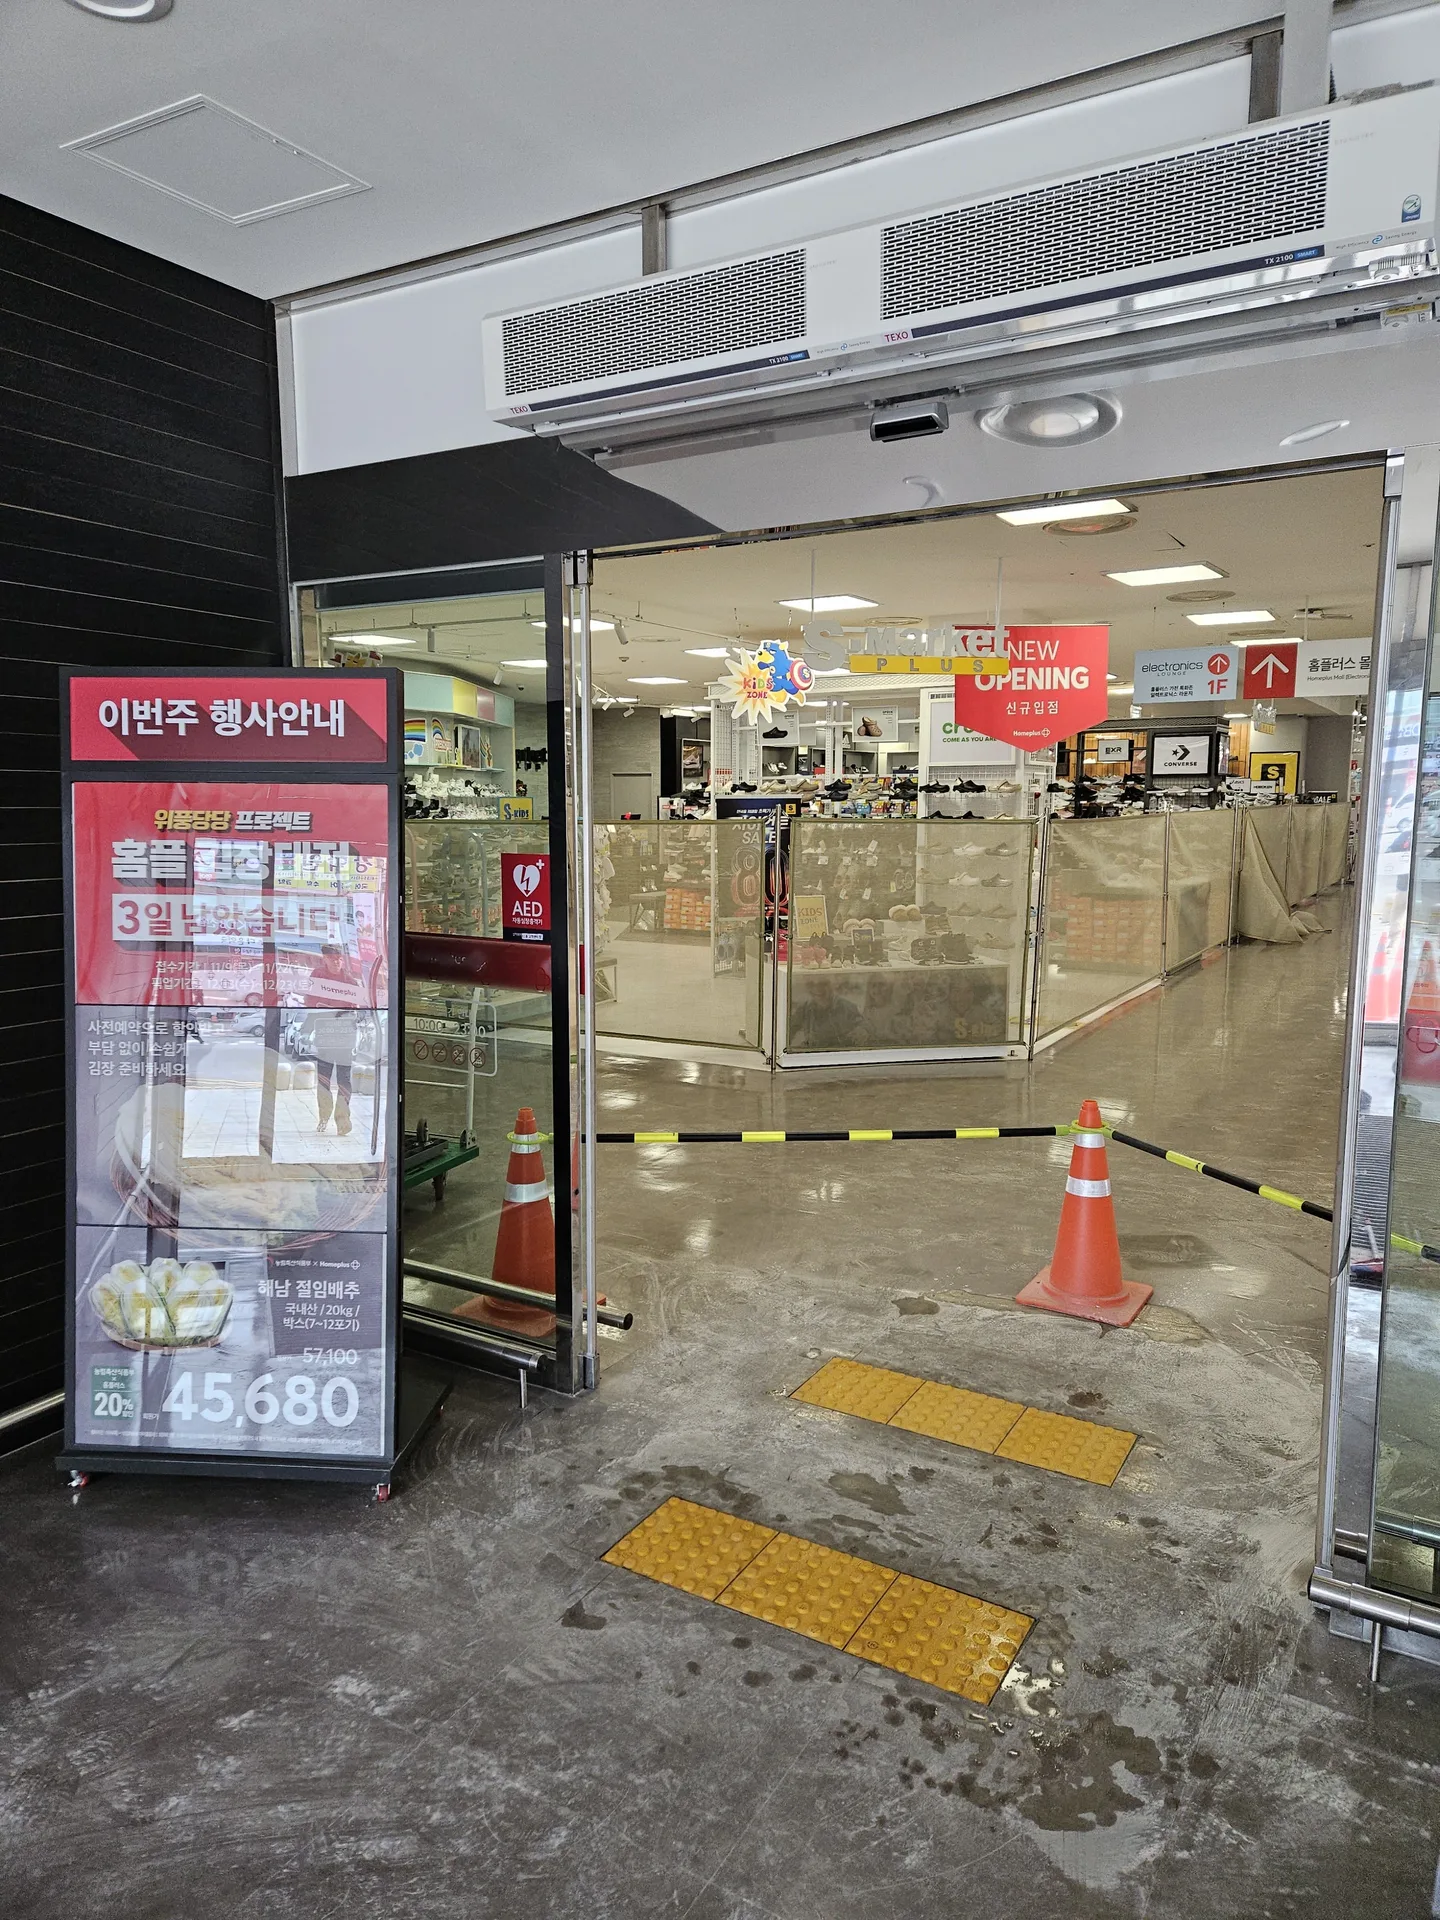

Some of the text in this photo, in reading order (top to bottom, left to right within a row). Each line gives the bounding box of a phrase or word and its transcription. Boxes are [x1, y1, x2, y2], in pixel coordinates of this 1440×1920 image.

[1265, 257, 1275, 265] TX
[1276, 253, 1294, 263] 2100
[885, 331, 909, 343] TEXO
[776, 355, 789, 364] 2100
[510, 405, 529, 415] TEXO
[1007, 640, 1060, 662] NEW
[877, 657, 984, 673] PLUS
[1141, 660, 1204, 673] electronics
[1307, 655, 1371, 673] 홈플러스 몰
[974, 665, 1090, 692] OPENING
[1156, 670, 1188, 678] LOUNGE
[1307, 674, 1333, 682] Homeplus
[1333, 673, 1345, 681] Mall
[1207, 678, 1228, 695] 1F
[746, 690, 769, 700] ZONE
[99, 698, 345, 737] 이번주 행사안내
[1012, 728, 1041, 738] Homeplus
[1267, 765, 1281, 781] S
[154, 809, 312, 831] 위풍당당 프로젝트
[111, 838, 188, 880] 홈플
[512, 900, 543, 917] AED
[117, 899, 173, 937] 3일
[155, 960, 200, 975] 접수기간
[151, 976, 196, 991] 픽업기간
[87, 1019, 169, 1036] 사전예약으로
[413, 1017, 443, 1033] 10:00
[87, 1040, 117, 1056] 부담
[118, 1040, 145, 1057] 없이
[88, 1060, 114, 1076] 김장
[319, 1260, 350, 1270] Homeplus
[257, 1278, 361, 1301] 해남 절임배추
[284, 1302, 318, 1316] 국내산
[325, 1304, 354, 1318] 20kg
[283, 1317, 361, 1333] 박스(7~12포기)
[302, 1347, 359, 1367] 57,100
[161, 1370, 360, 1429] 45,680
